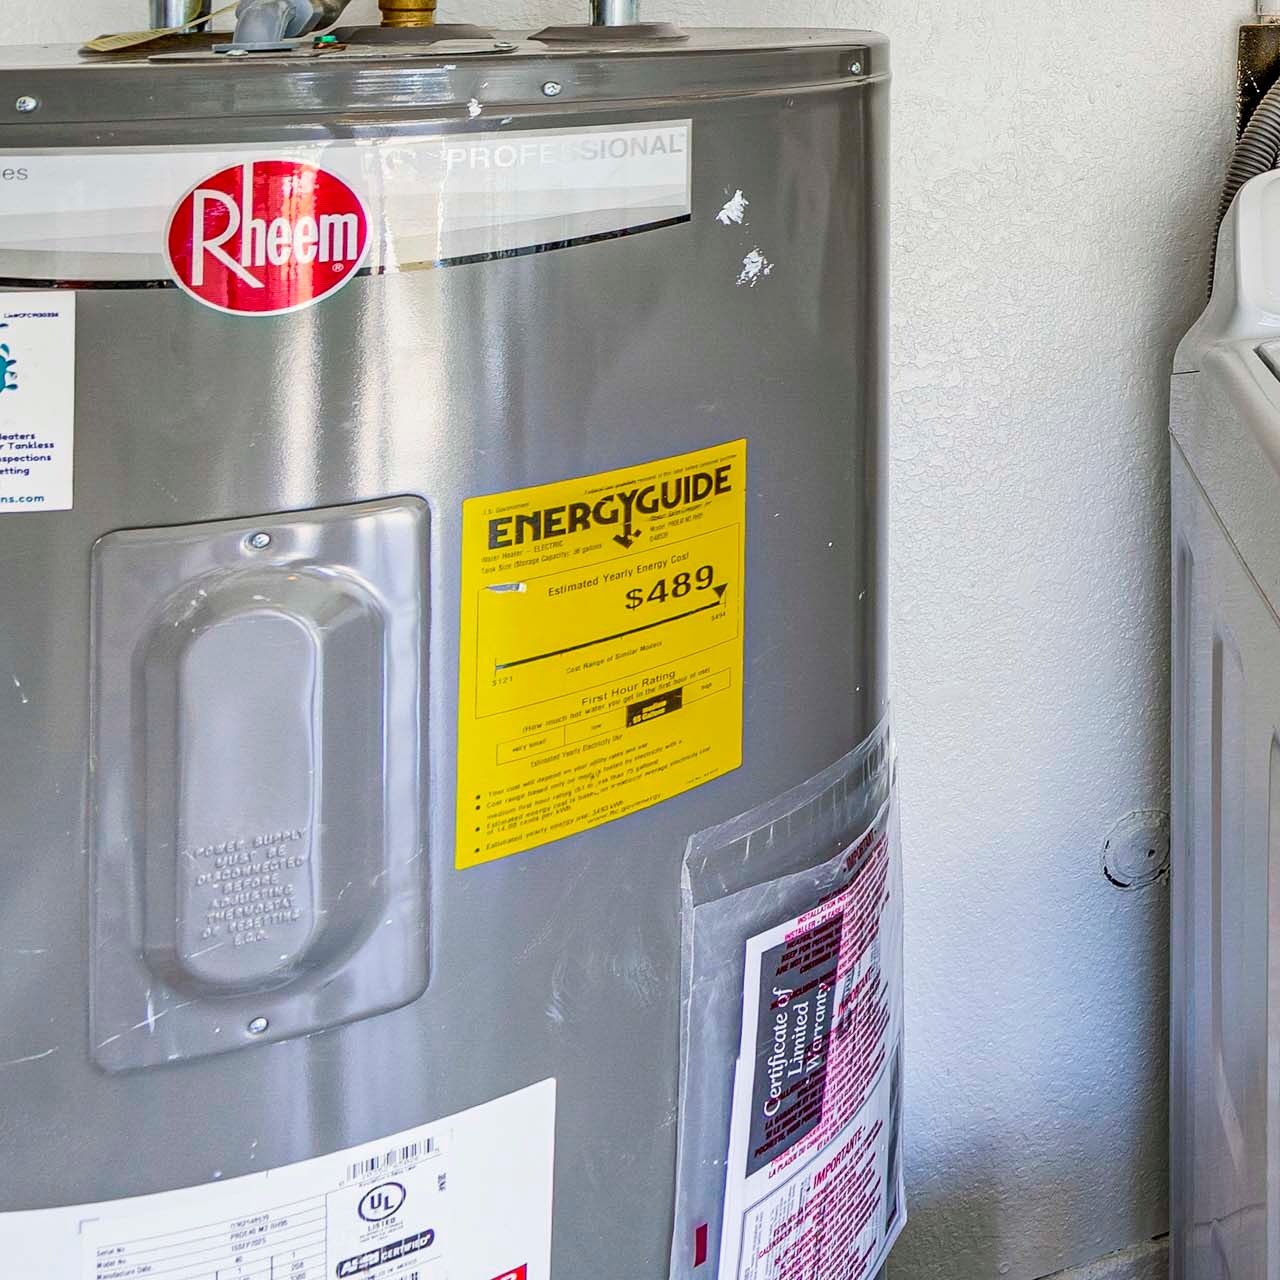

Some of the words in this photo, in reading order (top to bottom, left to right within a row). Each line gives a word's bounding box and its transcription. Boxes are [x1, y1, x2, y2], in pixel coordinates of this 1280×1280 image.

[191, 163, 358, 288] Rheem
[0, 454, 52, 463] spections
[8, 441, 55, 450] Tankless
[488, 464, 732, 550] ENERGYGUIDE
[548, 577, 599, 597] Estimated
[603, 569, 634, 587] Yearly
[637, 557, 668, 576] Energy
[670, 551, 690, 566] Cost
[625, 565, 714, 612] $489
[581, 692, 608, 706] First
[611, 684, 638, 699] Hour
[642, 671, 676, 688] Rating
[787, 1001, 809, 1078] Limited
[763, 1011, 789, 1116] Certificate
[370, 1193, 394, 1210] UL
